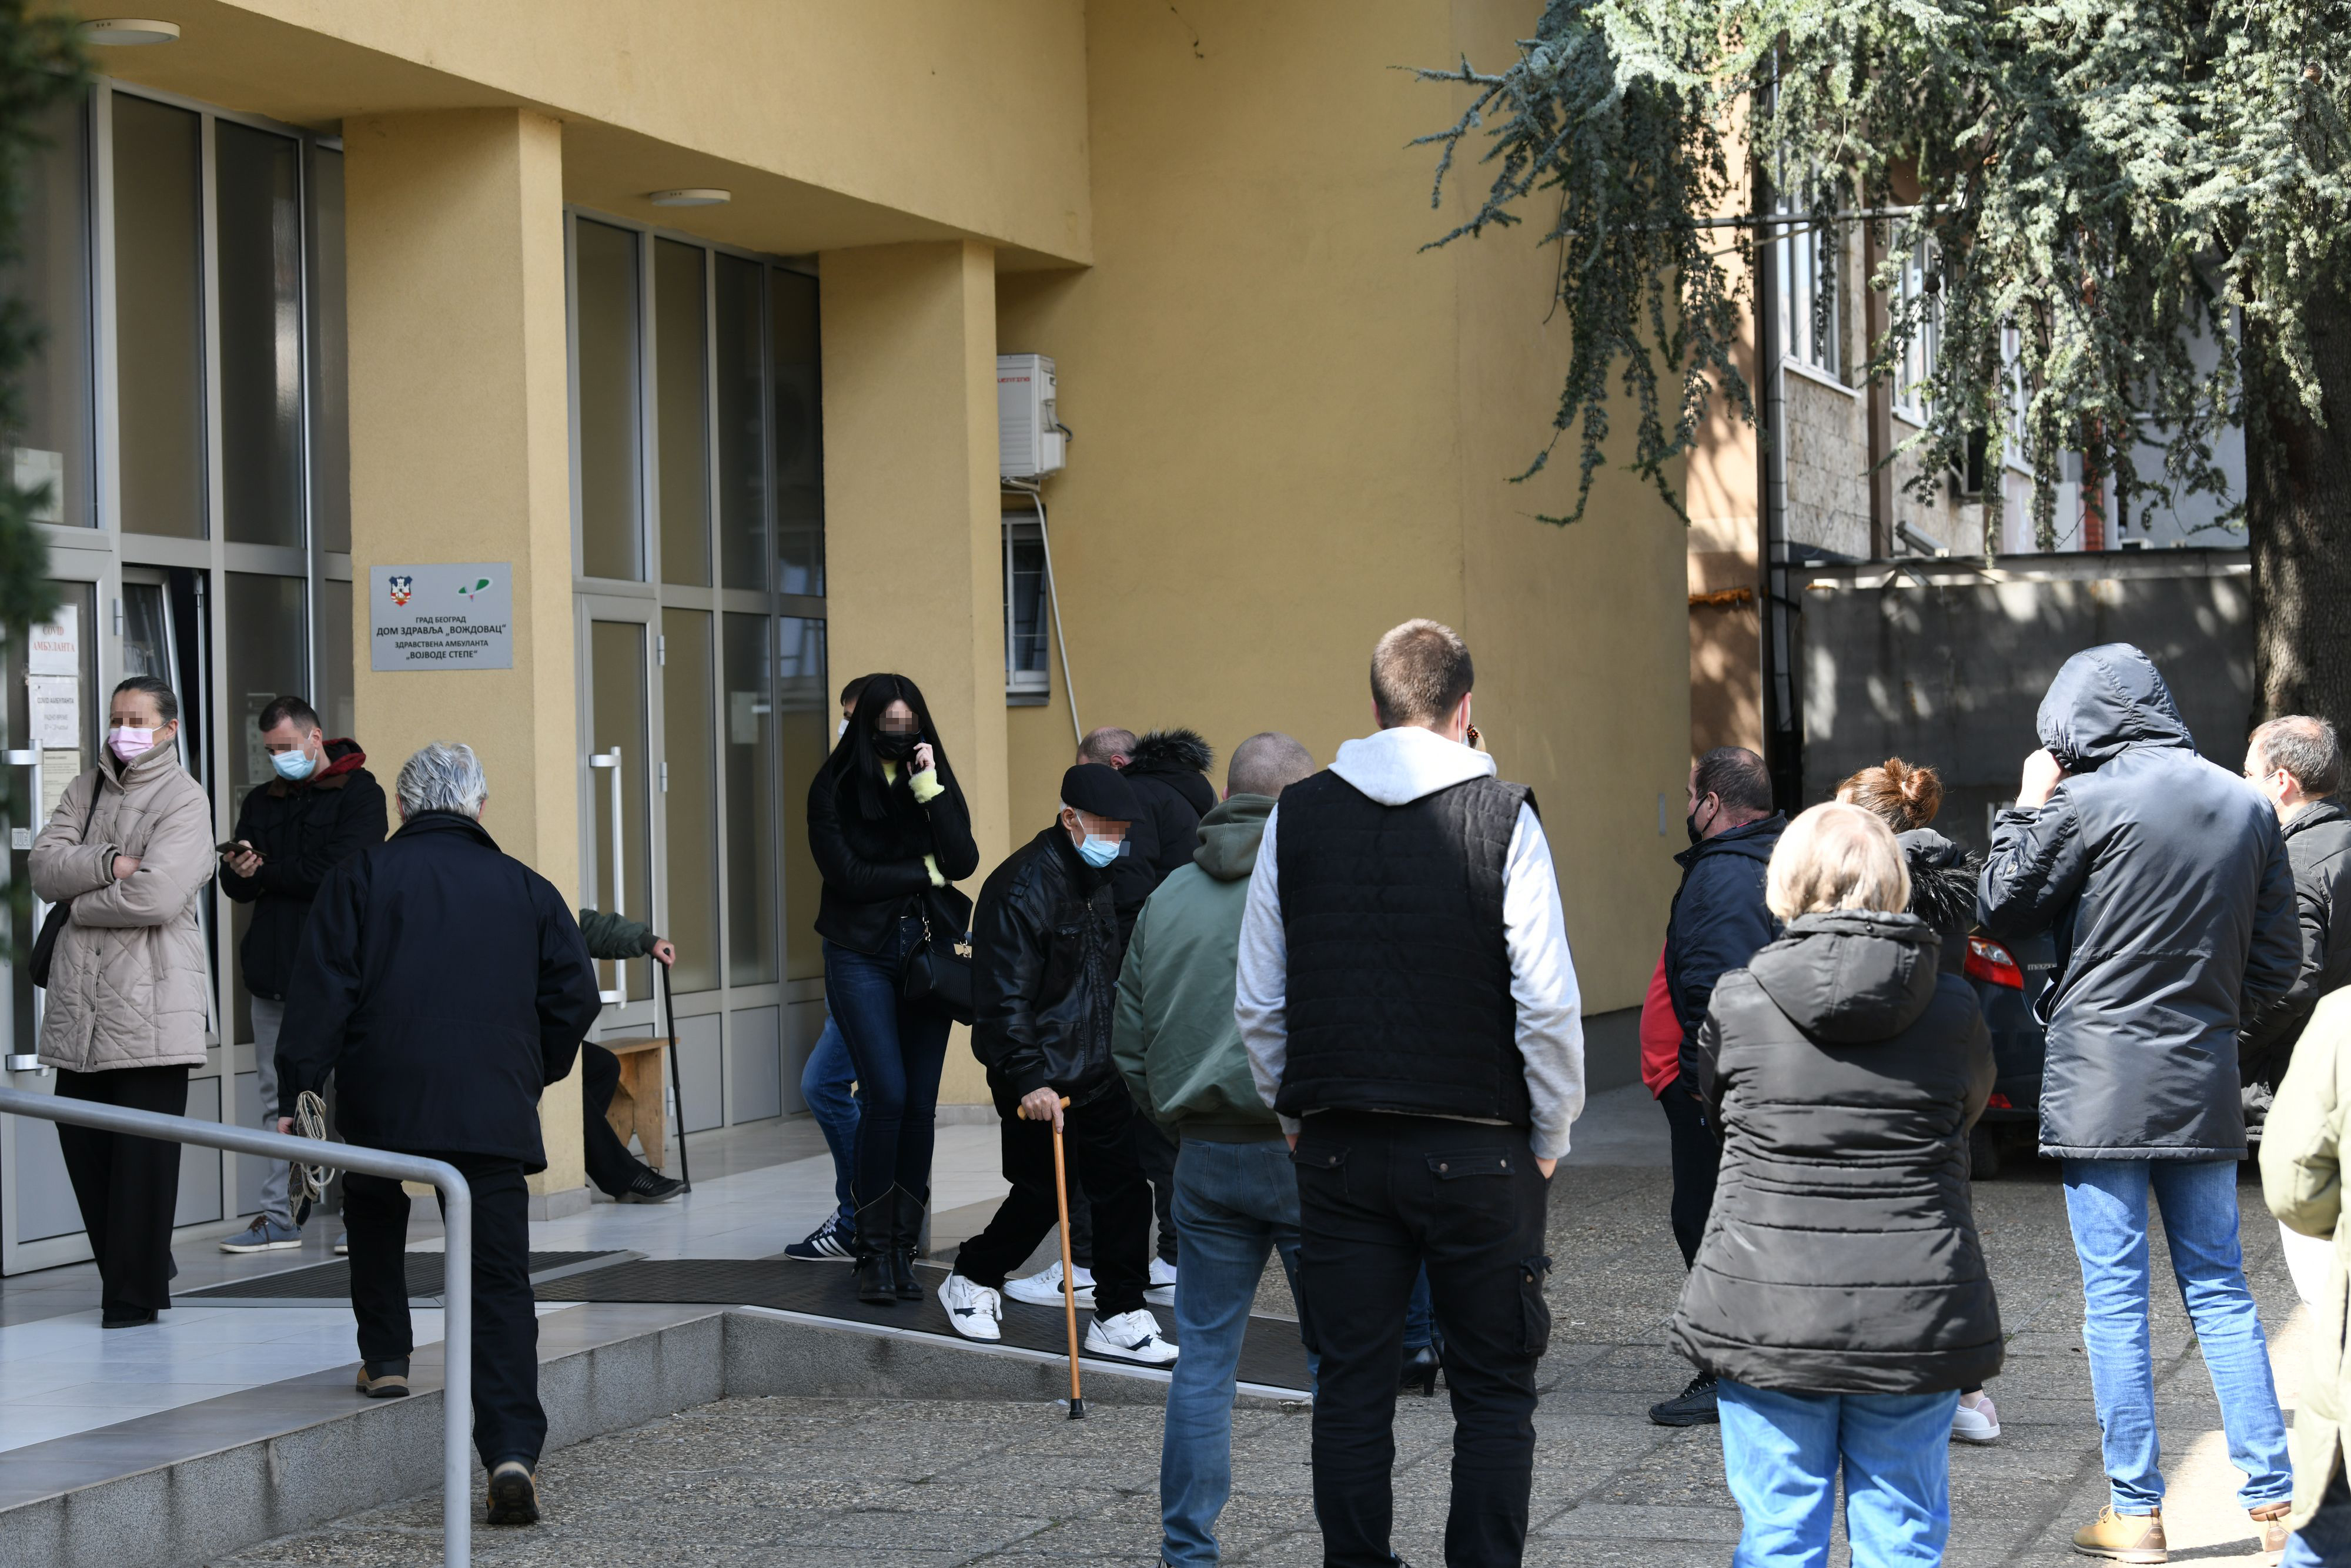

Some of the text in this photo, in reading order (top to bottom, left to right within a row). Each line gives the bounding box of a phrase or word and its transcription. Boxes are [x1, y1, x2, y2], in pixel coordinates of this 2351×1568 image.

[42, 625, 64, 636] COVID
[376, 627, 398, 637] ДОМ
[400, 626, 443, 636] ЗДРАВЉА
[33, 641, 75, 652] АМБУЛАНТА
